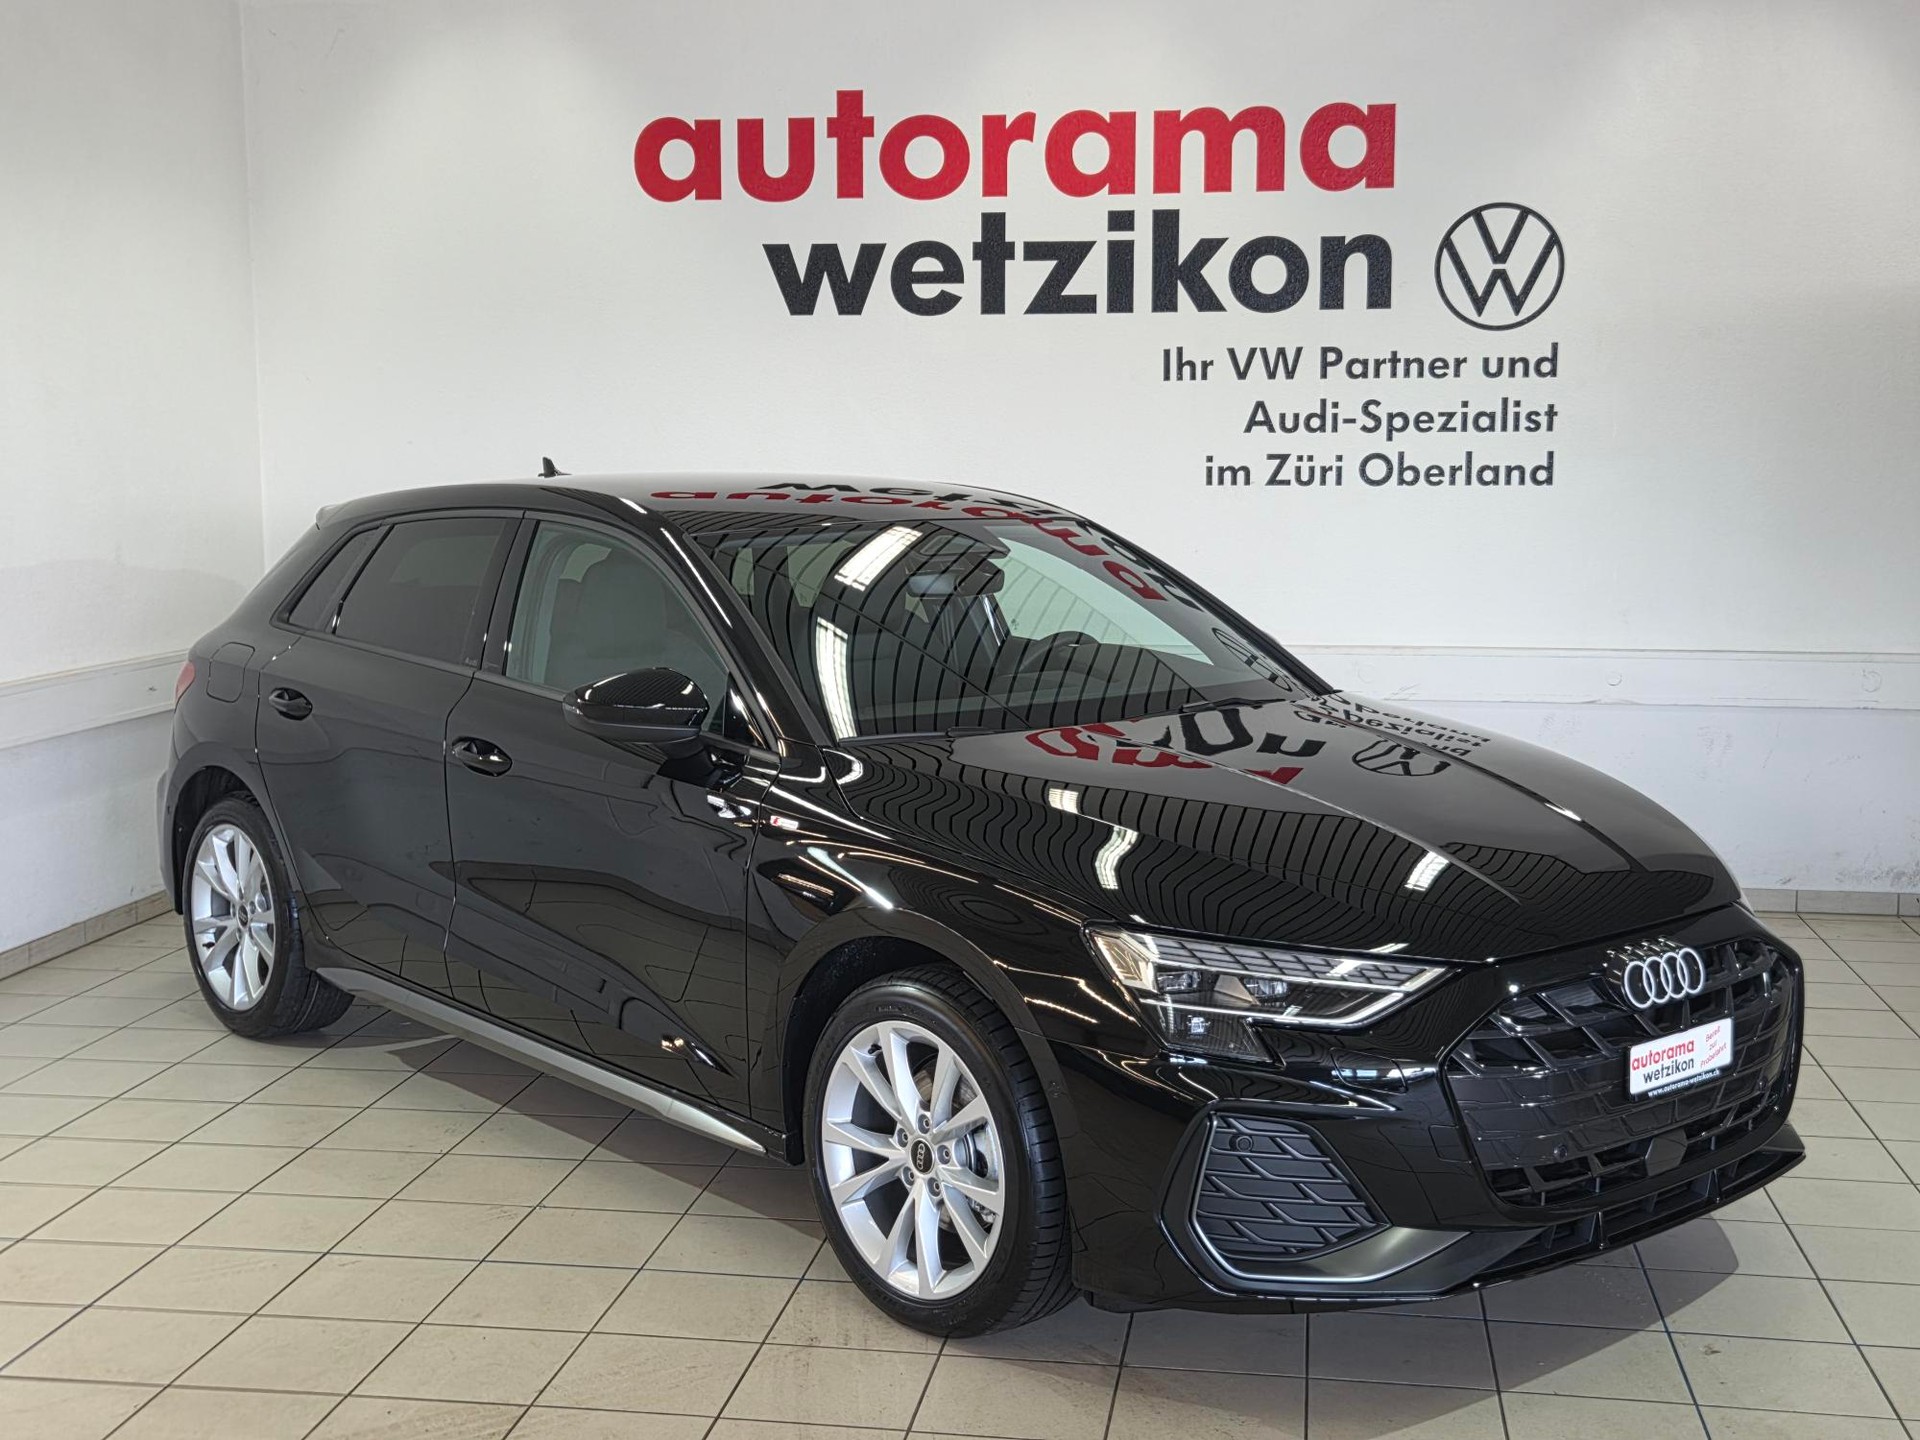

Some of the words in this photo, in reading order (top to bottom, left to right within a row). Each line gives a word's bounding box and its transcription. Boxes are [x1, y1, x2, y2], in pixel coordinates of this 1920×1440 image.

[634, 89, 1397, 203] autorama
[762, 208, 1393, 317] wetzikon
[1163, 346, 1214, 381] Ihr
[1226, 346, 1304, 380] VW
[1320, 346, 1468, 380] Partner
[1482, 342, 1559, 379] und
[1243, 396, 1558, 442] Audi-Spezialist
[1205, 454, 1251, 486] im
[1264, 452, 1343, 487] Züri
[1358, 450, 1554, 487] Oberland
[1631, 1039, 1695, 1071] autorama
[1642, 1057, 1695, 1084] wetzikon
